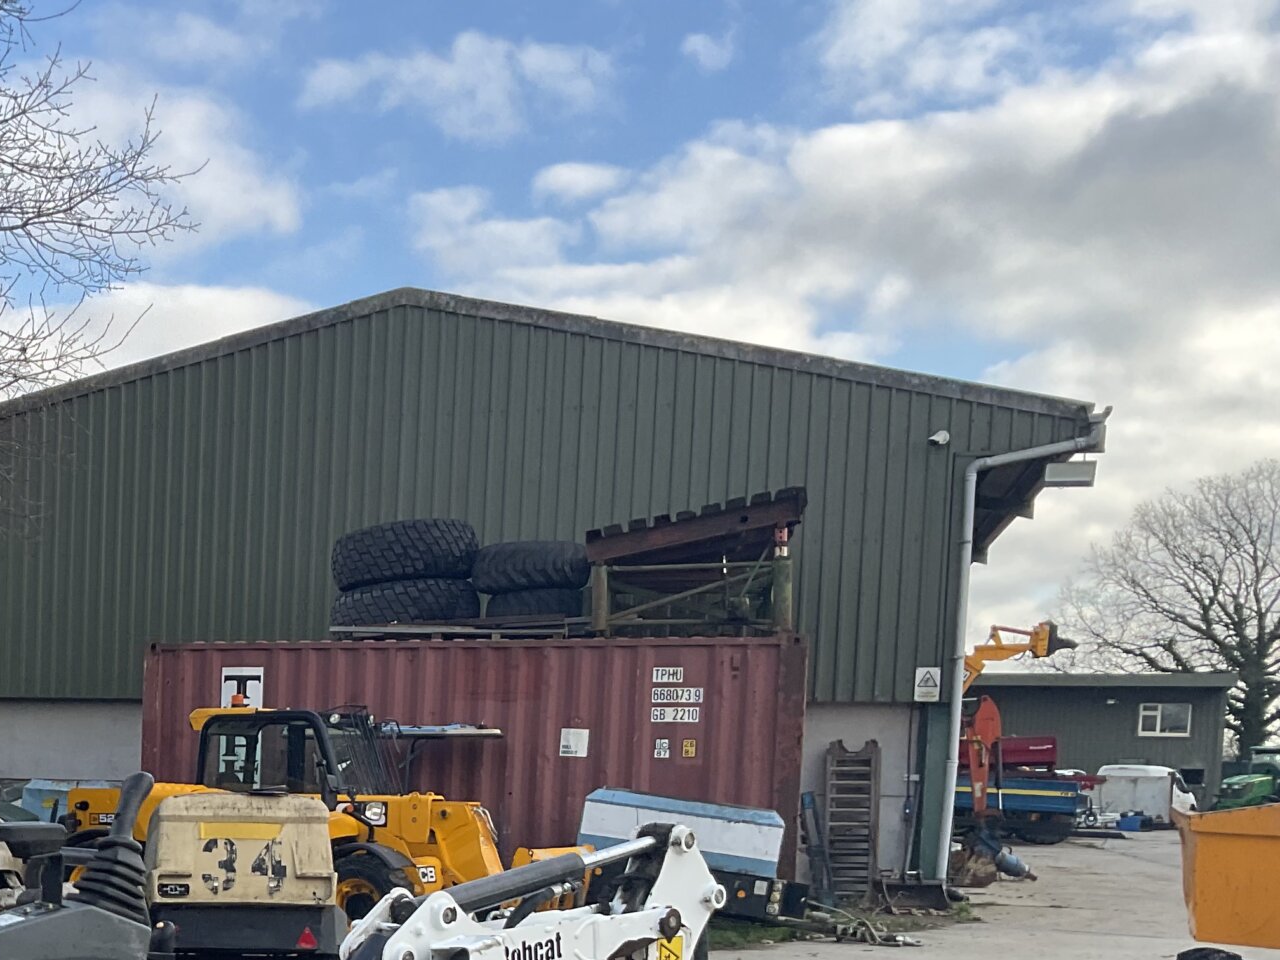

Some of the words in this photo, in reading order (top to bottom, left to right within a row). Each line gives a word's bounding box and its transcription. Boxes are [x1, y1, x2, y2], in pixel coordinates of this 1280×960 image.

[654, 669, 682, 681] TPHU
[652, 708, 666, 721] GB
[672, 708, 698, 721] 2210
[99, 814, 115, 823] 52
[202, 838, 287, 896] 34
[416, 867, 436, 882] CB
